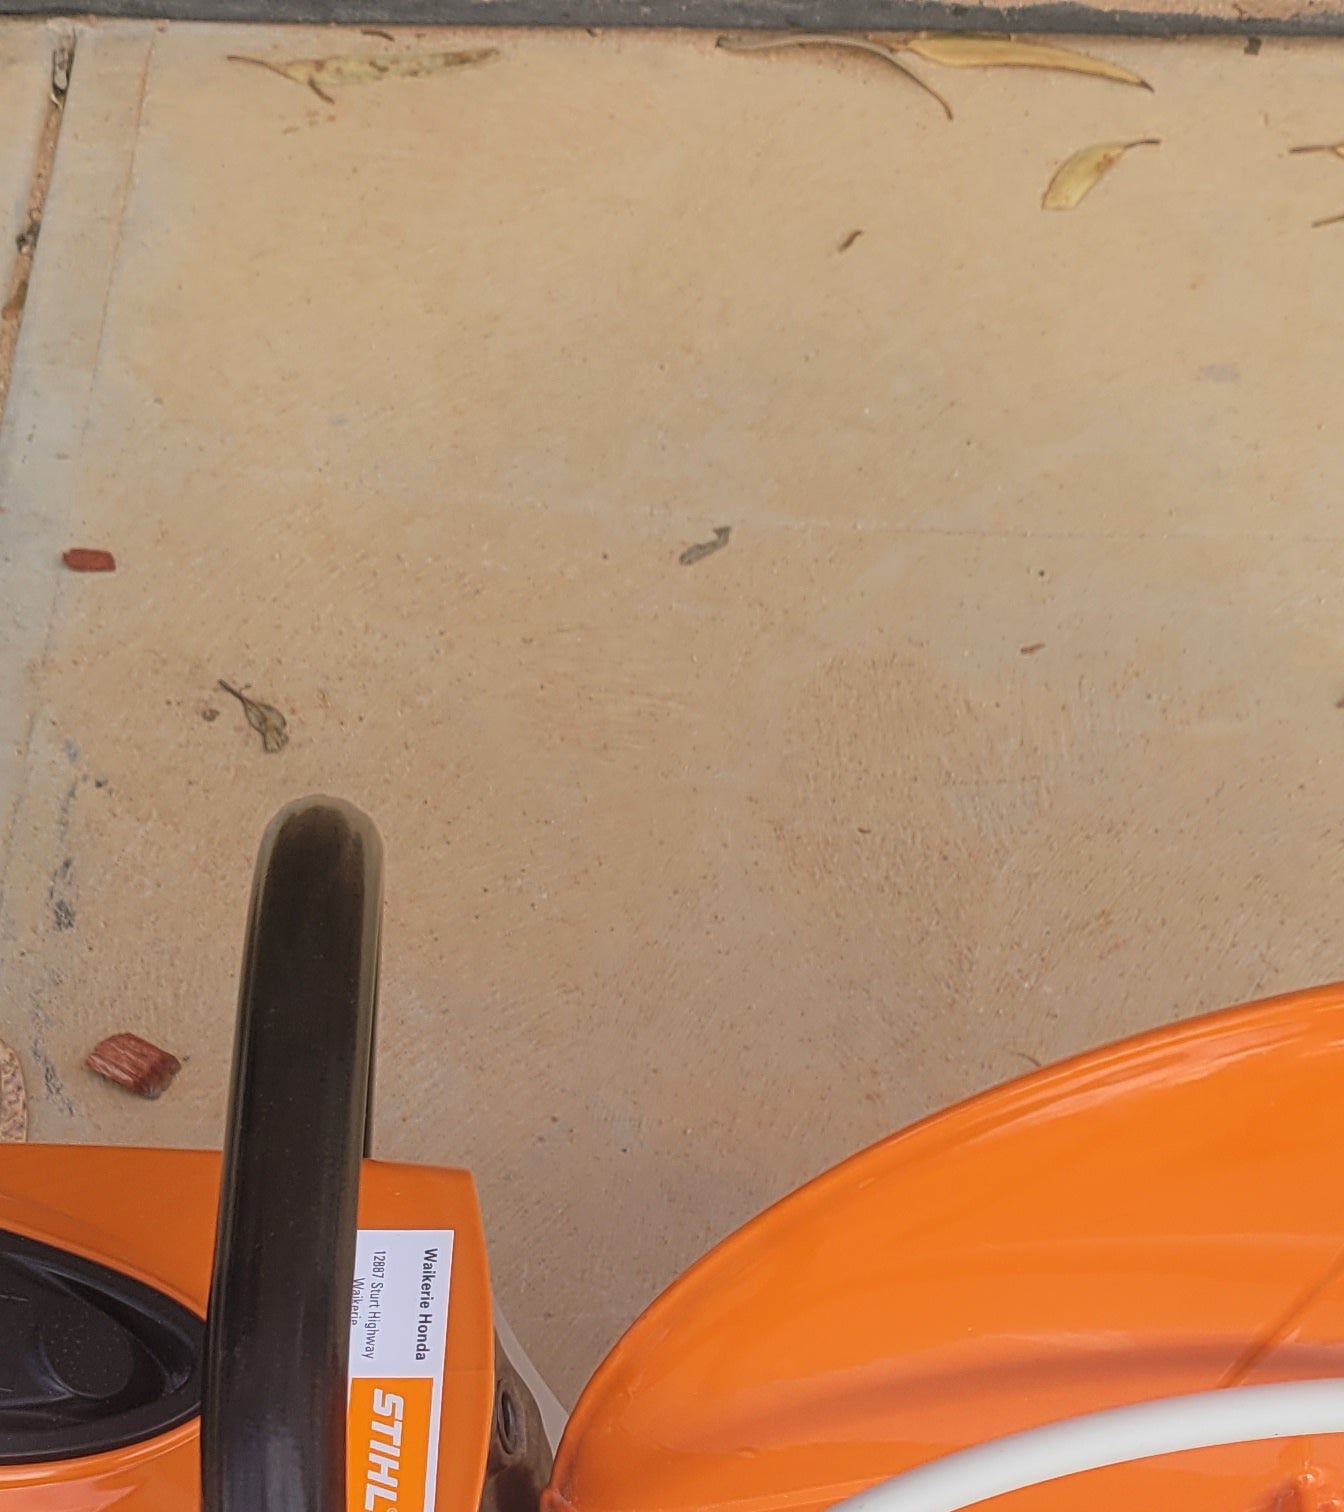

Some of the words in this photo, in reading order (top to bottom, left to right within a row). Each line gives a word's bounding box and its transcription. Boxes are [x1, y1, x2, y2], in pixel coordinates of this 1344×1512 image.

[372, 1250, 387, 1279] 12887
[419, 1248, 438, 1309] Waikerie
[368, 1282, 384, 1308] Sturt
[361, 1311, 382, 1360] Highway
[415, 1313, 433, 1361] Honda
[364, 1387, 404, 1512] STIHL
